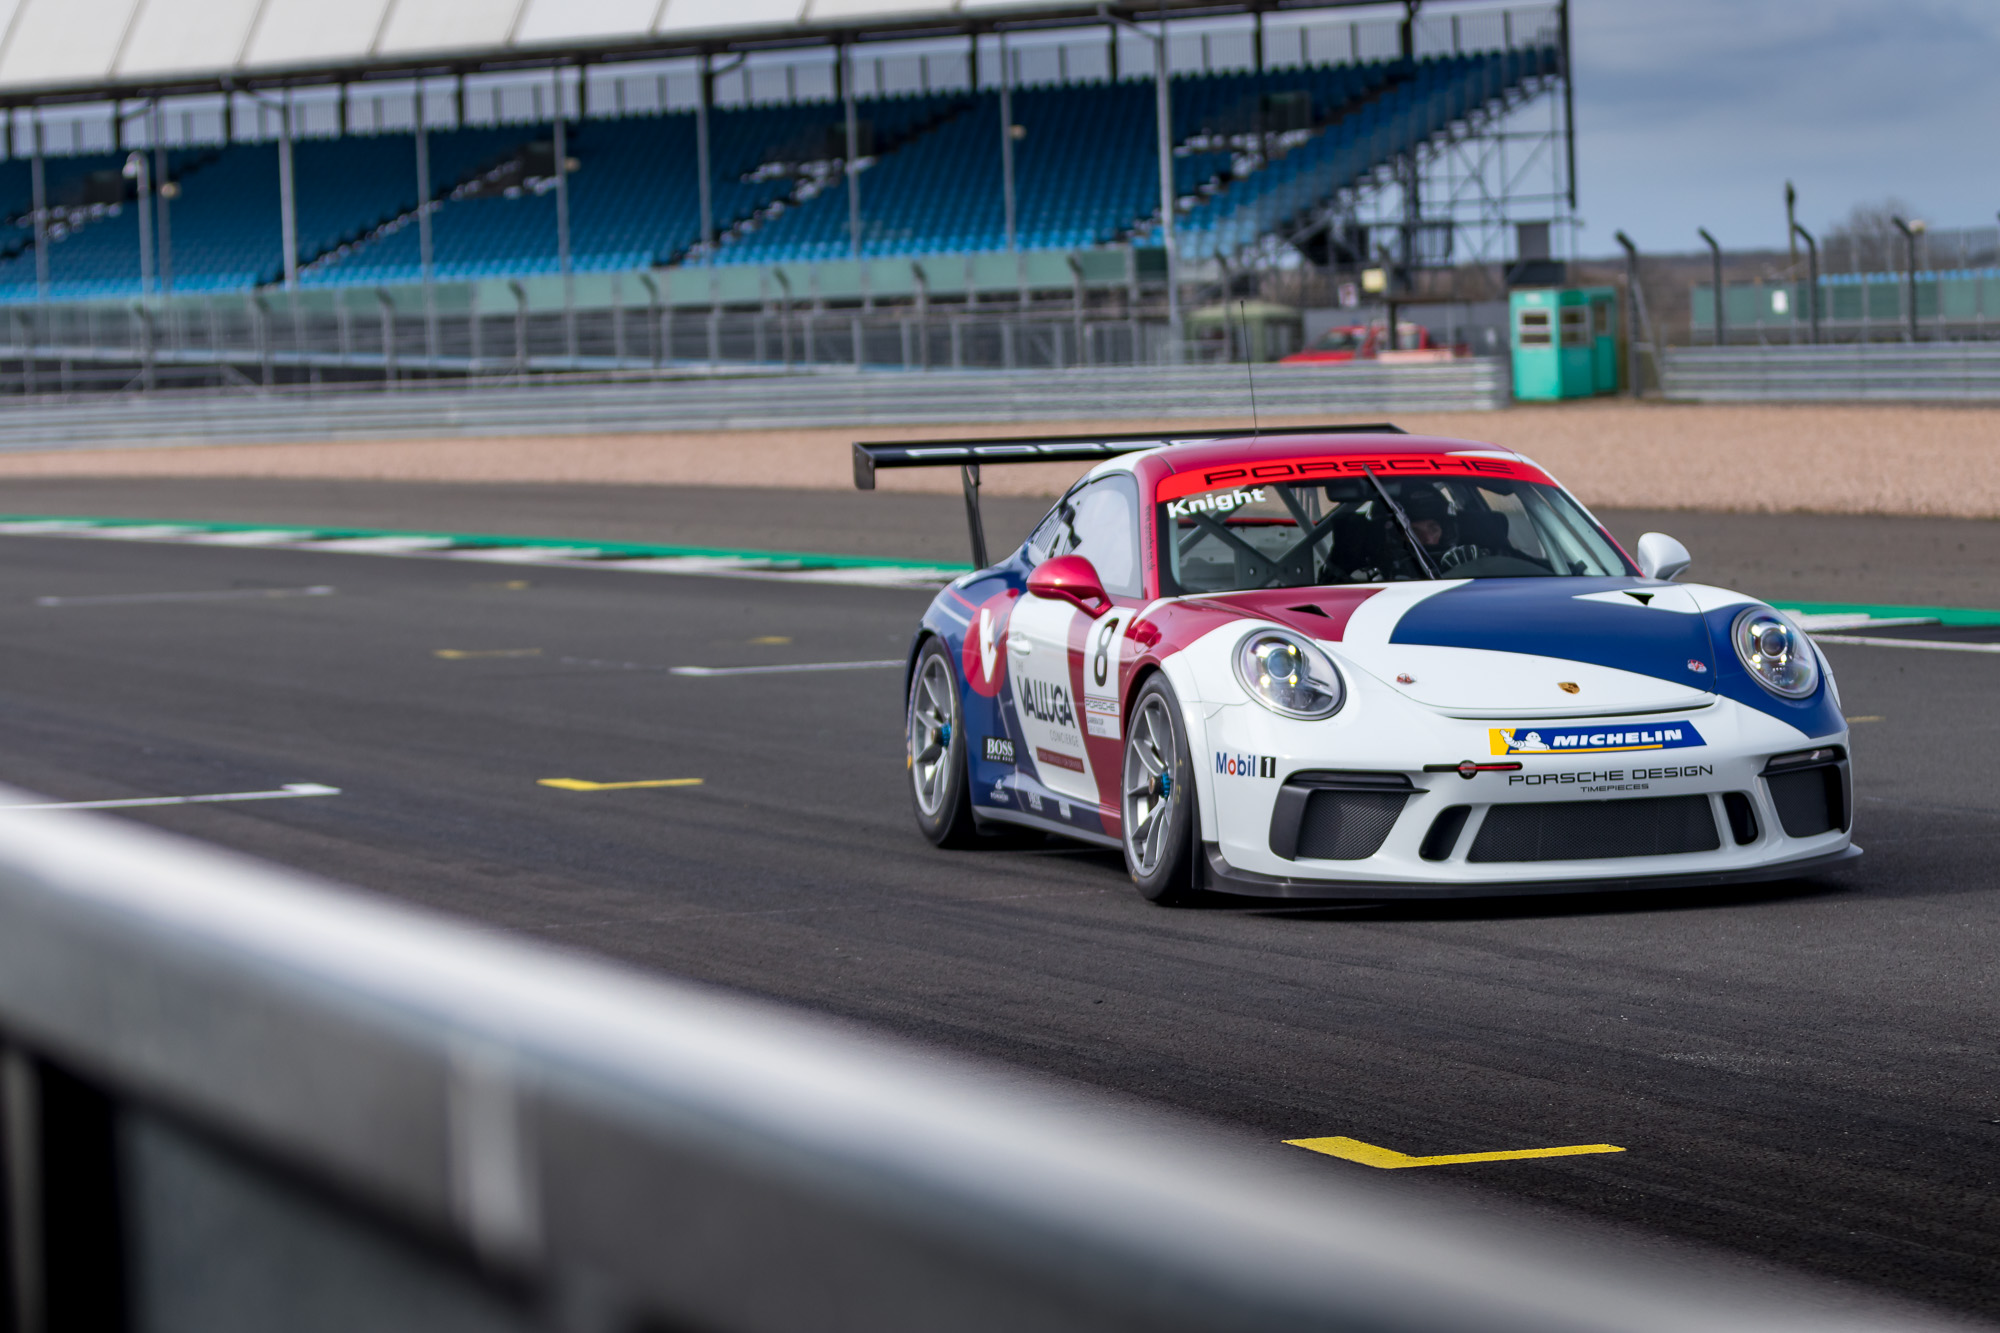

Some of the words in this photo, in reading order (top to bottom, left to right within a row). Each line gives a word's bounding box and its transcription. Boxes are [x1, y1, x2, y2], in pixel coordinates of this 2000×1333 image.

[1203, 459, 1515, 486] PORSCHE
[1166, 488, 1267, 519] Knight
[1094, 617, 1119, 687] 8
[1017, 675, 1076, 729] VALLUGA
[1085, 699, 1116, 712] PORSCHE
[986, 738, 1014, 757] BOSS
[1552, 729, 1683, 747] MICHELIN
[1216, 751, 1256, 777] Mobil
[1508, 770, 1624, 786] PORSCHE
[1632, 764, 1713, 780] DESIGN
[1580, 783, 1649, 793] TIMEPIECES
